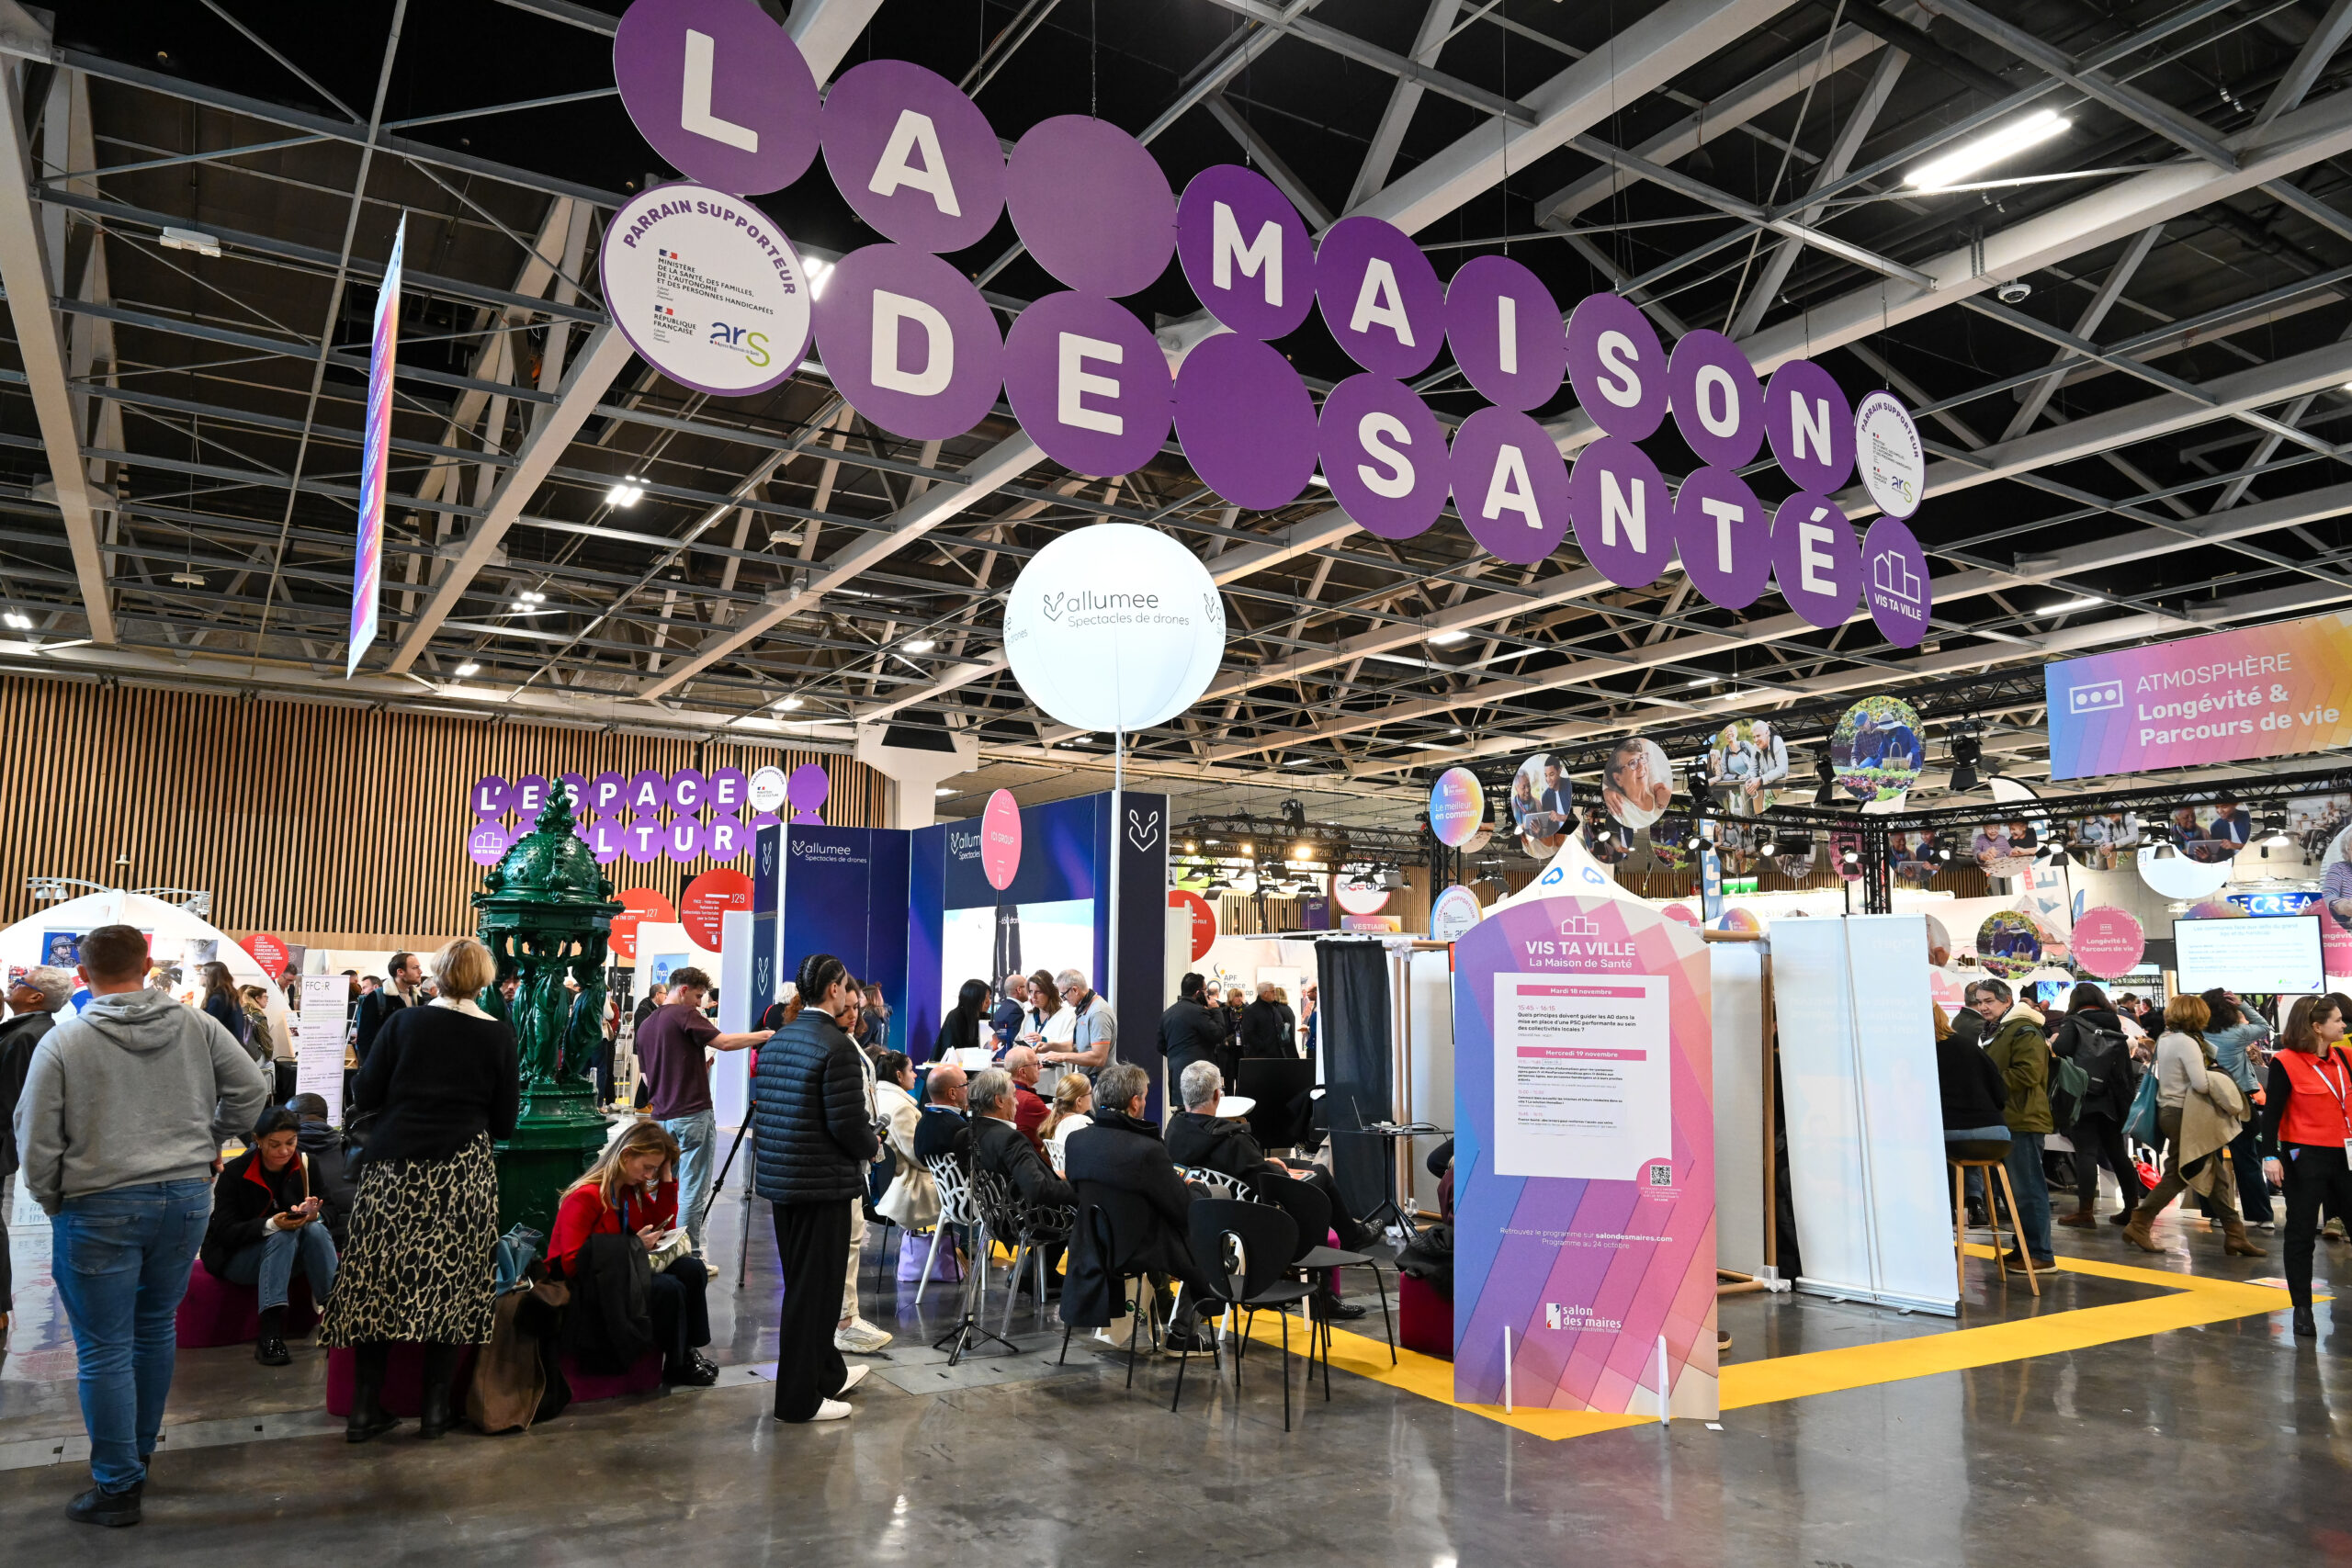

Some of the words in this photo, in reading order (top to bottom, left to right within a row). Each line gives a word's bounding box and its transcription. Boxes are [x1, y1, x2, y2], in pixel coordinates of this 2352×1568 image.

[623, 200, 692, 248] PARRAIN
[696, 200, 796, 294] SUPPORTEUR
[681, 28, 962, 218] LA
[1212, 199, 1833, 468] MAISON
[658, 257, 695, 273] MINISTÈRE
[657, 264, 667, 272] DE
[669, 266, 678, 276] LA
[706, 278, 719, 287] DES
[656, 277, 665, 286] ET
[667, 280, 681, 290] DES
[682, 285, 724, 301] PERSONNES
[725, 297, 774, 315] HANDICAPÉES
[653, 313, 696, 330] RÉPUBLIQUE
[653, 320, 694, 336] FRANÇAISE
[710, 321, 771, 367] ars
[1861, 402, 1883, 433] PARRAIN
[1883, 402, 1919, 458] SUPPORTEUR
[871, 288, 1123, 435] DE
[1357, 411, 1838, 598] SANTÉ
[1892, 476, 1913, 503] ars
[1067, 591, 1159, 613] allumee
[1874, 592, 1888, 608] VIS
[1889, 598, 1899, 613] TA
[1900, 603, 1922, 621] VILLE
[1068, 612, 1132, 628] Spectacles
[1136, 612, 1150, 624] de
[1153, 612, 1190, 626] drones
[2136, 652, 2292, 694] ATMOSPHÈRE
[2138, 686, 2262, 721] Longévité
[2269, 683, 2289, 703] &
[2140, 719, 2254, 746] Parcours
[2260, 712, 2292, 731] de
[2299, 705, 2339, 726] vie
[1435, 804, 1443, 812] Le
[1444, 801, 1472, 811] meilleur
[1445, 809, 1477, 819] commun
[805, 842, 851, 855] allumee
[959, 832, 981, 849] allum
[958, 851, 981, 861] Spectacles
[731, 893, 745, 904] J29
[646, 908, 658, 918] J27
[1352, 922, 1390, 931] VESTIAIRE
[1526, 941, 1555, 954] VIS
[1559, 942, 1580, 955] TA
[1588, 942, 1635, 956] VILLE
[1530, 957, 1543, 967] La
[1545, 958, 1582, 967] Maison
[1585, 958, 1598, 968] de
[1600, 958, 1633, 968] Santé
[1499, 1227, 1533, 1235] Retrouvez
[1543, 1230, 1582, 1239] programme
[1596, 1232, 1673, 1242] salondesmaires.com
[1542, 1238, 1581, 1247] Programme
[1603, 1241, 1630, 1249] octobre
[1563, 1304, 1593, 1315] salon
[1563, 1314, 1582, 1325] des
[1585, 1316, 1622, 1328] maires
